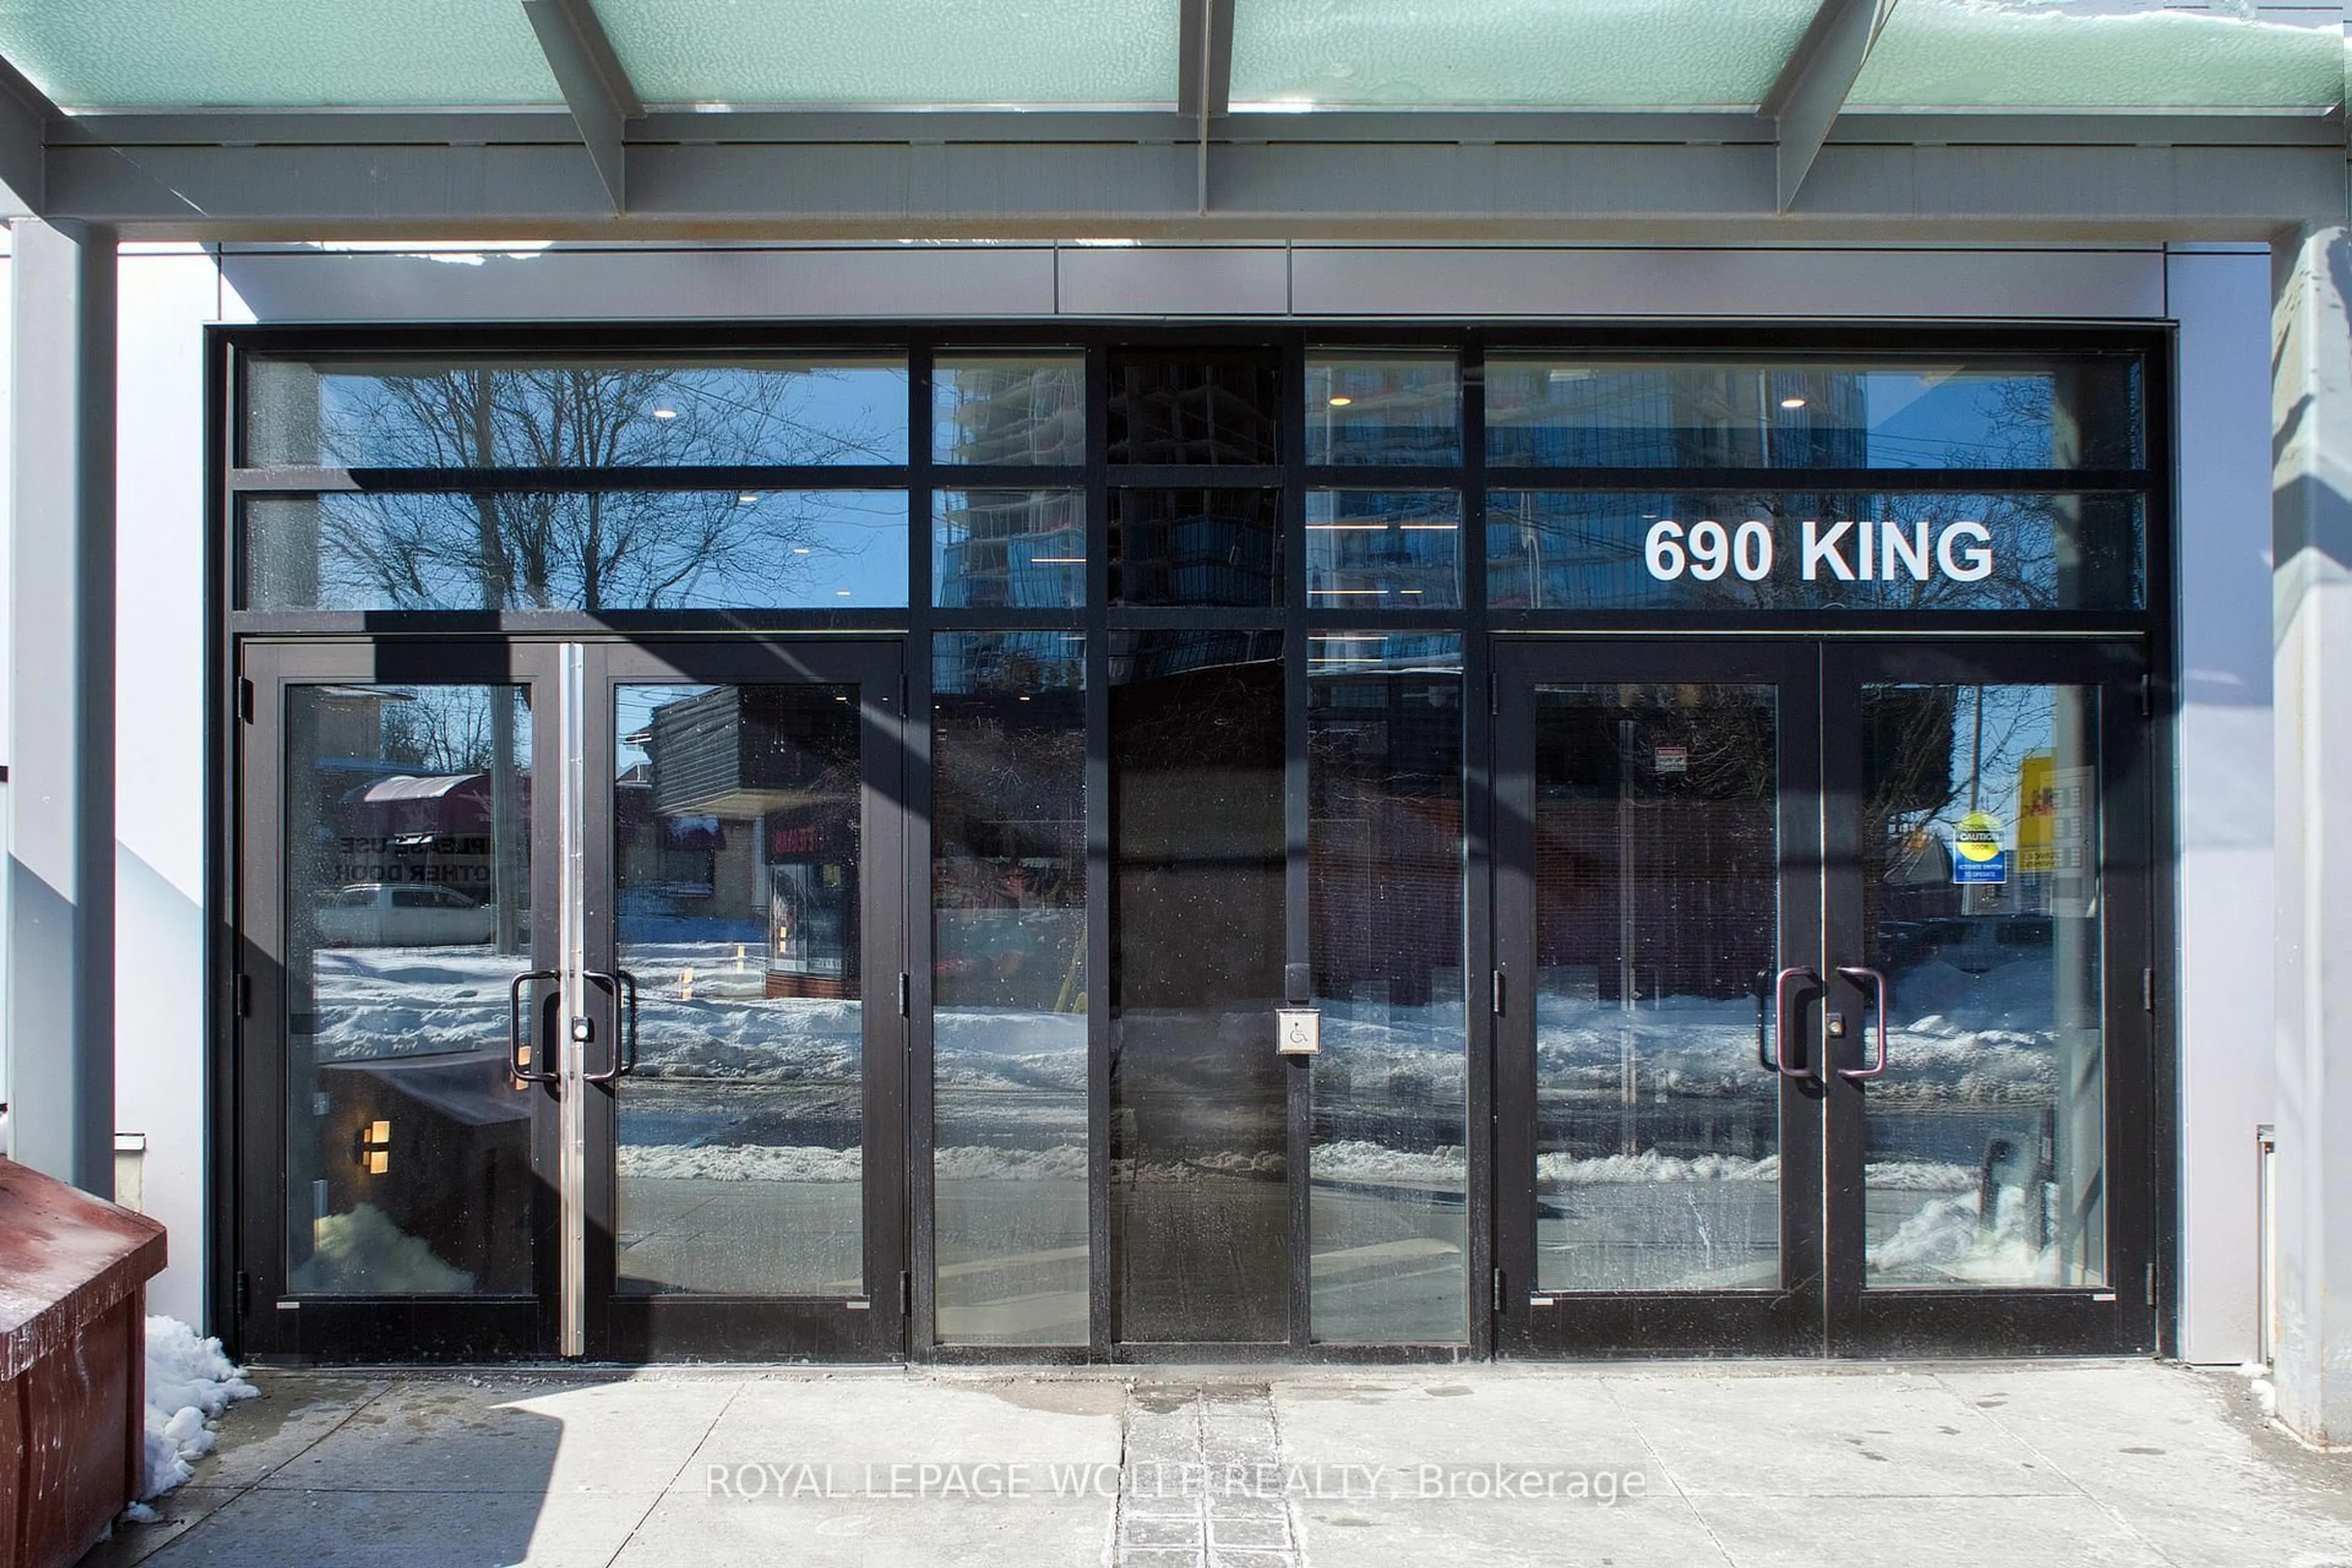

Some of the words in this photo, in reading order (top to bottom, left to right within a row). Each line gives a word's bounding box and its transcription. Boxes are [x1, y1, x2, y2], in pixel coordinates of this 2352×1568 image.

[1645, 519, 1773, 582] 690
[1801, 519, 1992, 582] KING
[1959, 832, 1999, 841] CAUTION
